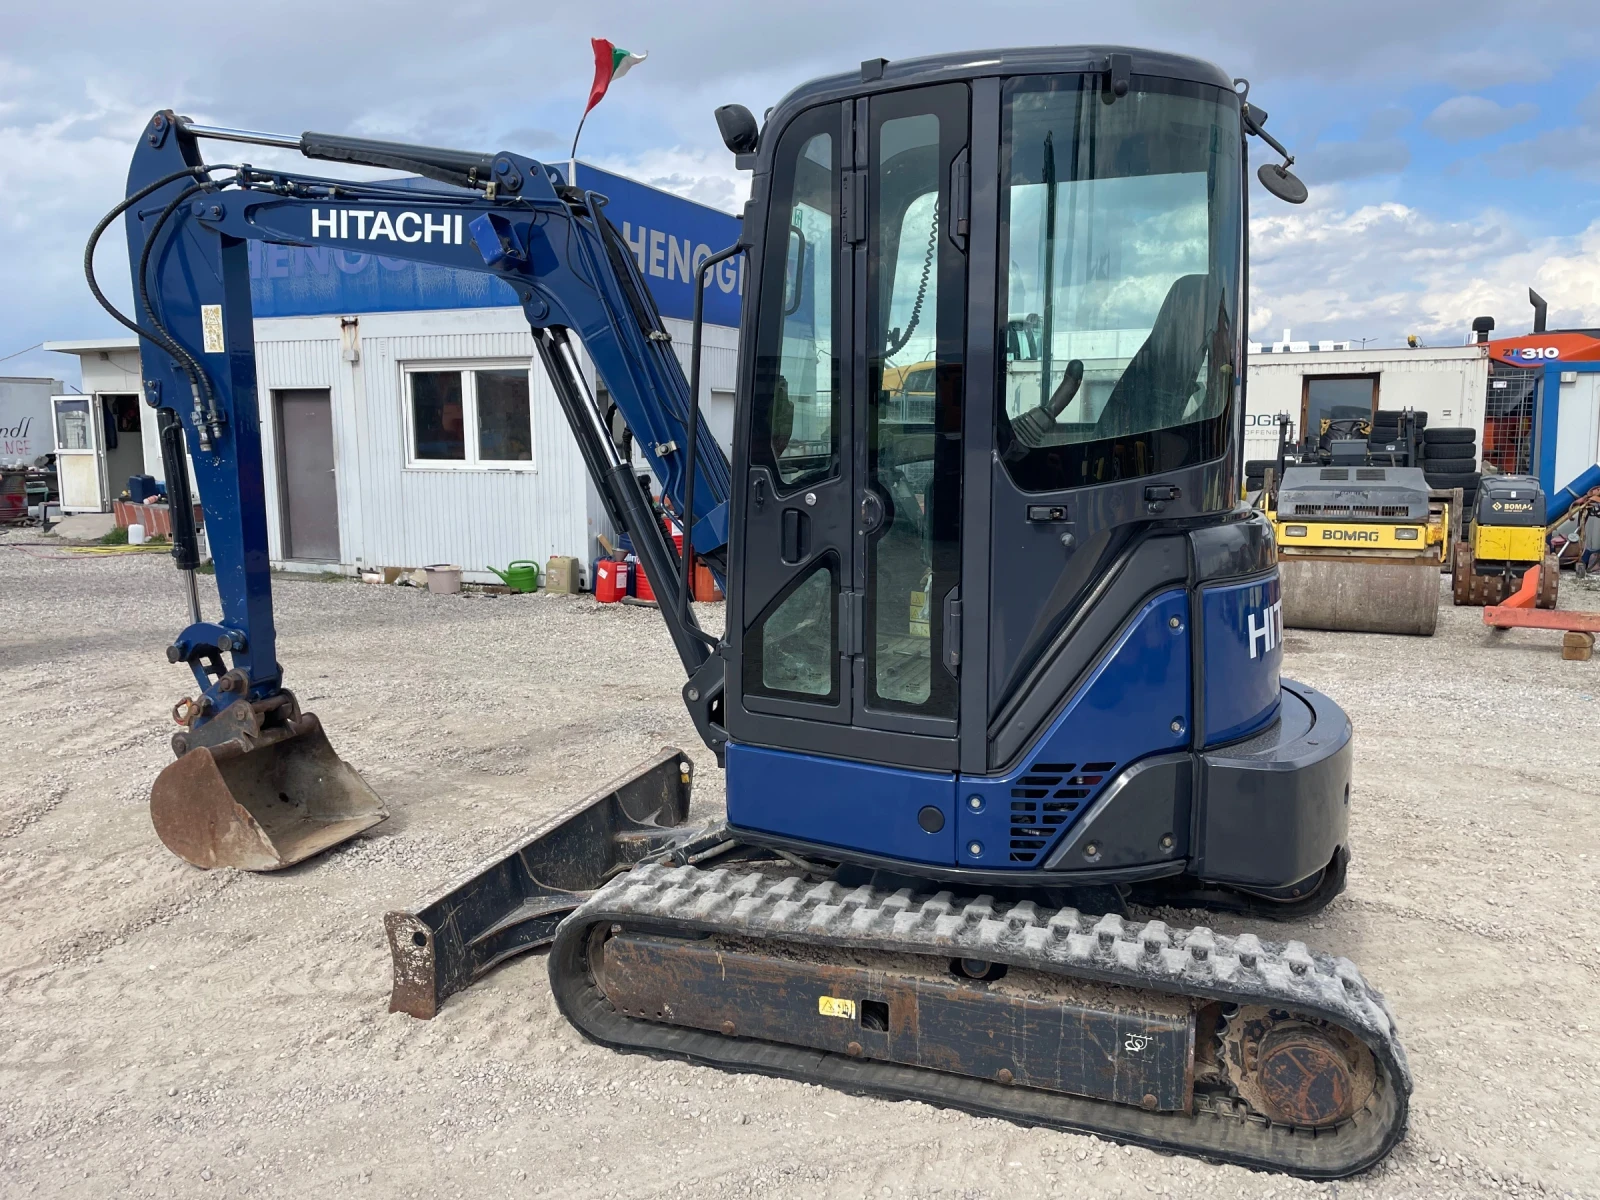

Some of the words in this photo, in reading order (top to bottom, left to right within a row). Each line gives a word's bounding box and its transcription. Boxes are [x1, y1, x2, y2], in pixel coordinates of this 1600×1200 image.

[311, 208, 462, 244] HITACHI
[1504, 503, 1533, 511] BOMAG
[1322, 529, 1379, 542] BOMAG
